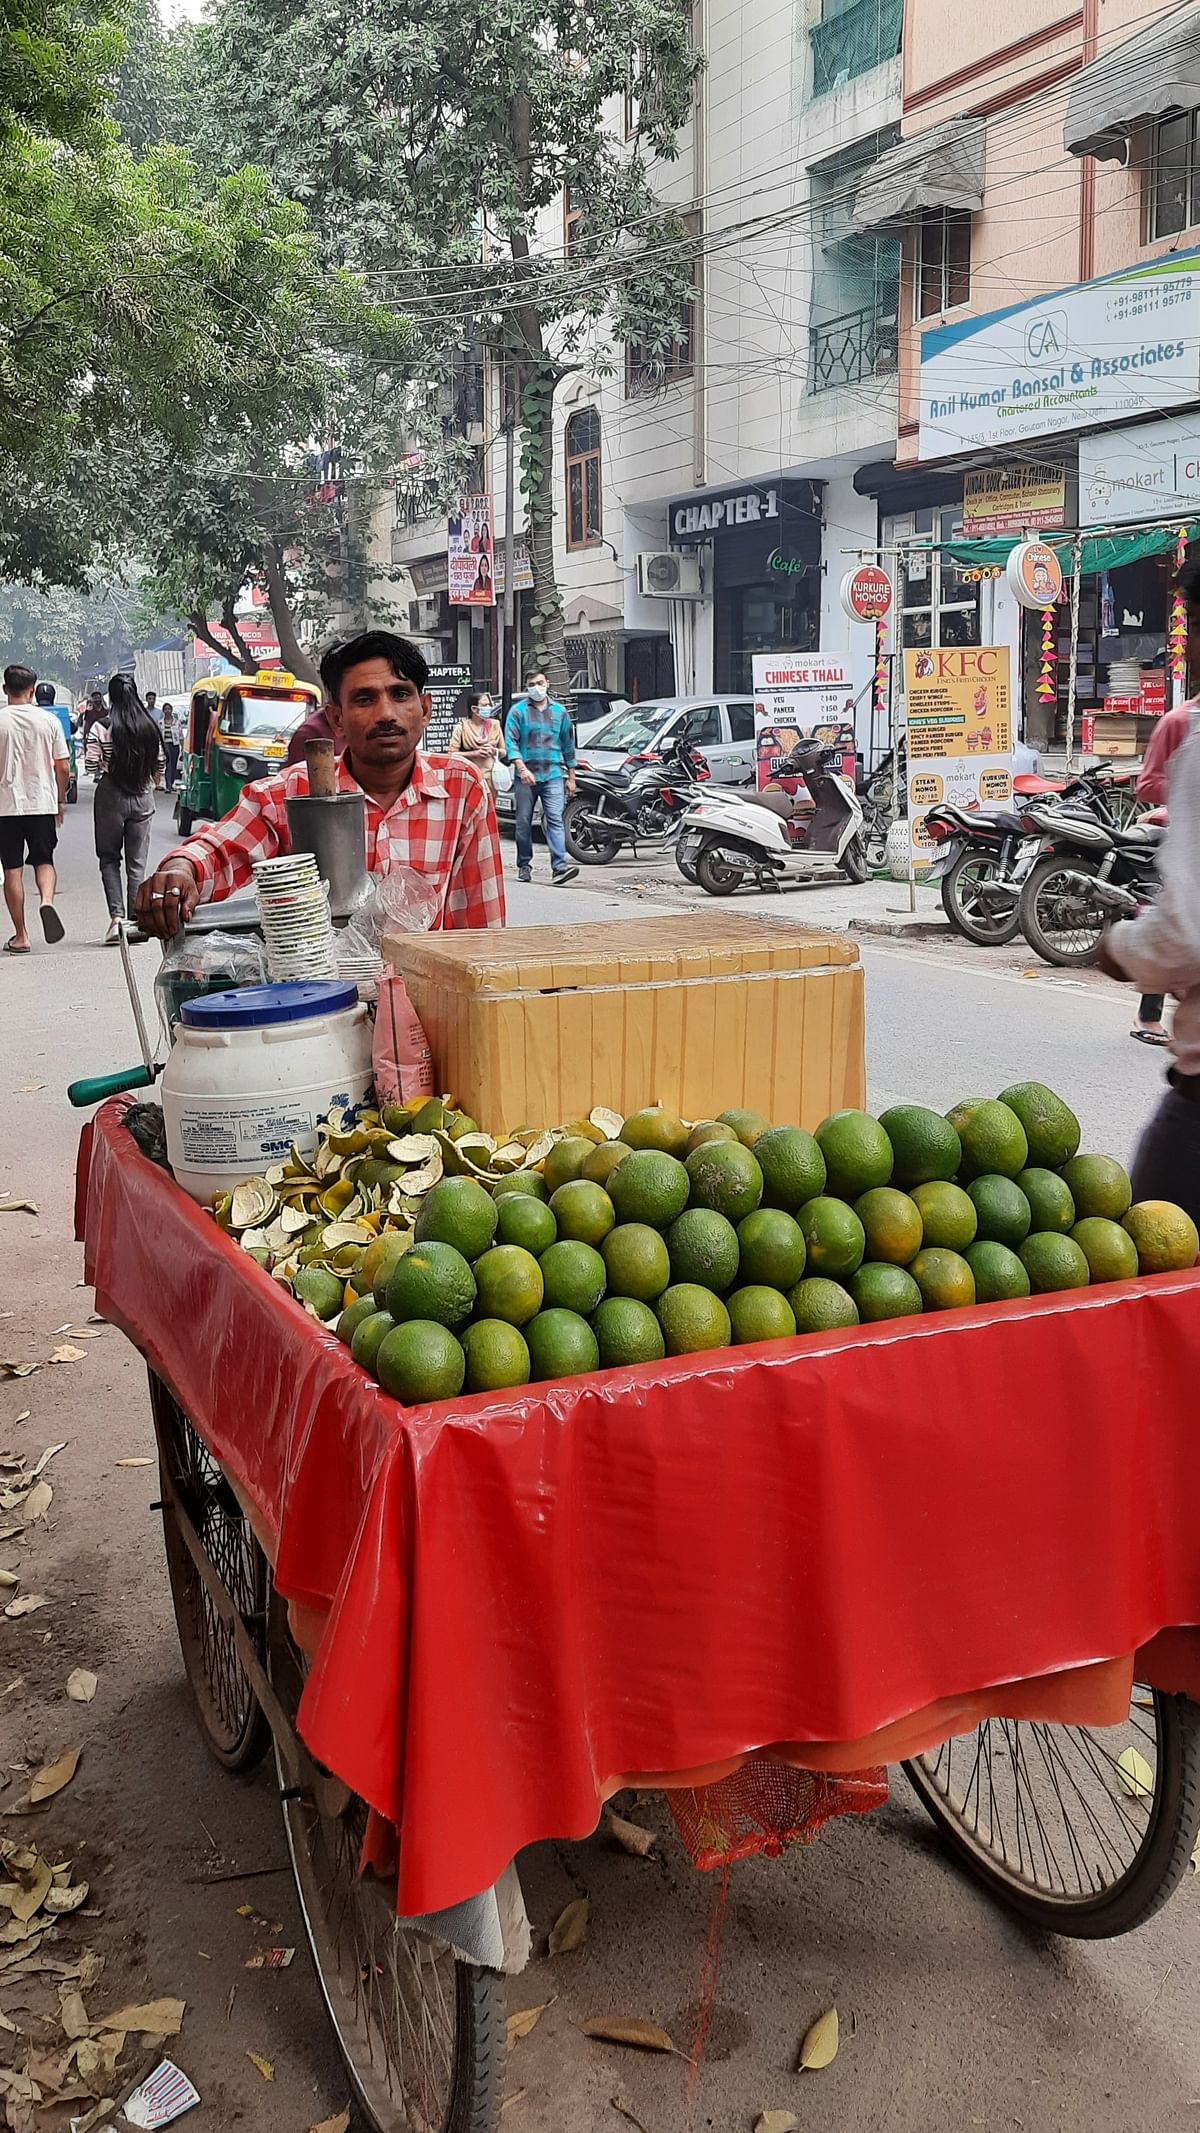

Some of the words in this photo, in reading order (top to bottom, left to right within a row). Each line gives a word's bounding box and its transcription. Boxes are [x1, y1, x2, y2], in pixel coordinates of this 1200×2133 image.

[1113, 286, 1159, 306] +91-98111
[1163, 276, 1192, 293] 95779
[1113, 299, 1159, 320] +91-98111
[1163, 291, 1192, 307] 95778
[930, 395, 956, 419] Anil
[960, 388, 1007, 412] Kumar
[1012, 367, 1065, 399] Bansal
[1071, 363, 1083, 384] &
[1091, 340, 1185, 379] Associates
[997, 396, 1041, 418] Chartered
[1043, 385, 1098, 407] Accountants
[1113, 469, 1165, 491] mokart
[675, 490, 779, 535] CHAPTER-1
[771, 556, 801, 575] Café
[853, 582, 891, 593] KURKURE
[855, 592, 888, 603] MOMOS
[794, 659, 825, 668] mokart
[936, 651, 998, 677] KFC
[765, 670, 809, 684] CHINESE
[812, 668, 844, 682] THALI
[773, 696, 785, 704] VEG
[773, 706, 795, 714] PANEER
[774, 716, 797, 724] CHICKEN
[946, 773, 976, 782] mokart
[261, 1140, 295, 1152] SMC
